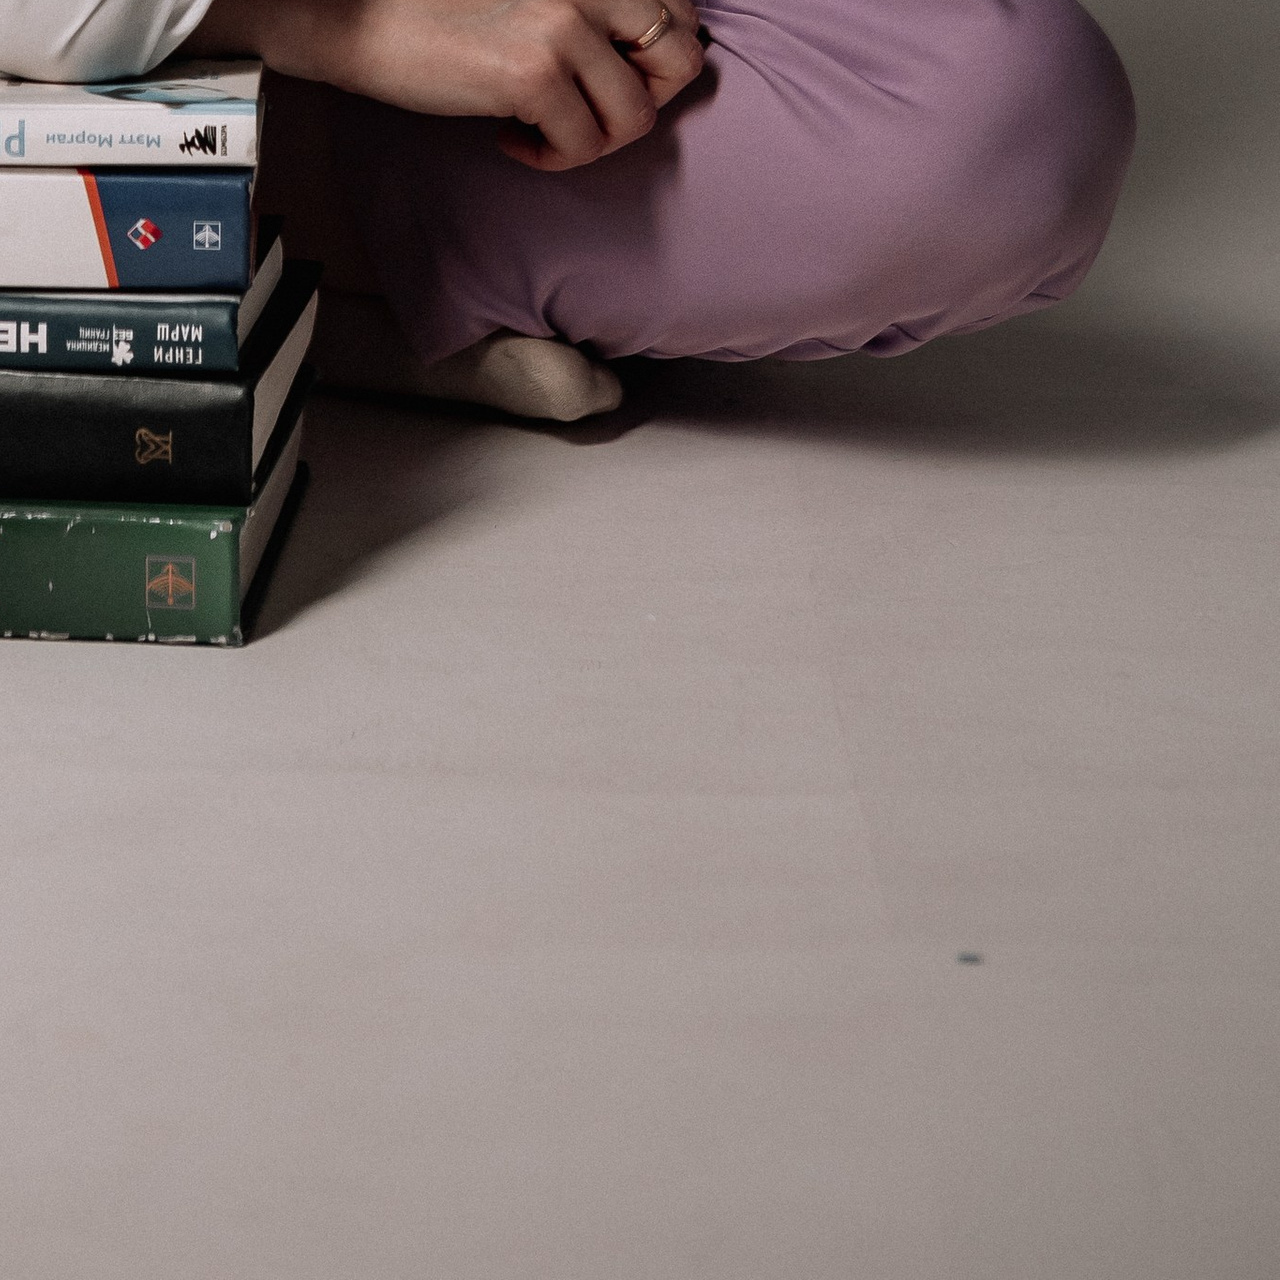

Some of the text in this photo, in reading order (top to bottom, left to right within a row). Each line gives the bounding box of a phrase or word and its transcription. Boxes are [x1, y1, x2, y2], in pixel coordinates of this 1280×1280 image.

[46, 131, 161, 148] Мэтт Морган
[79, 326, 110, 340] ГРАНИЦ
[157, 322, 203, 342] МАРШ
[66, 340, 110, 353] МЕДИЦИНА
[153, 346, 202, 364] ГЕНРИ
